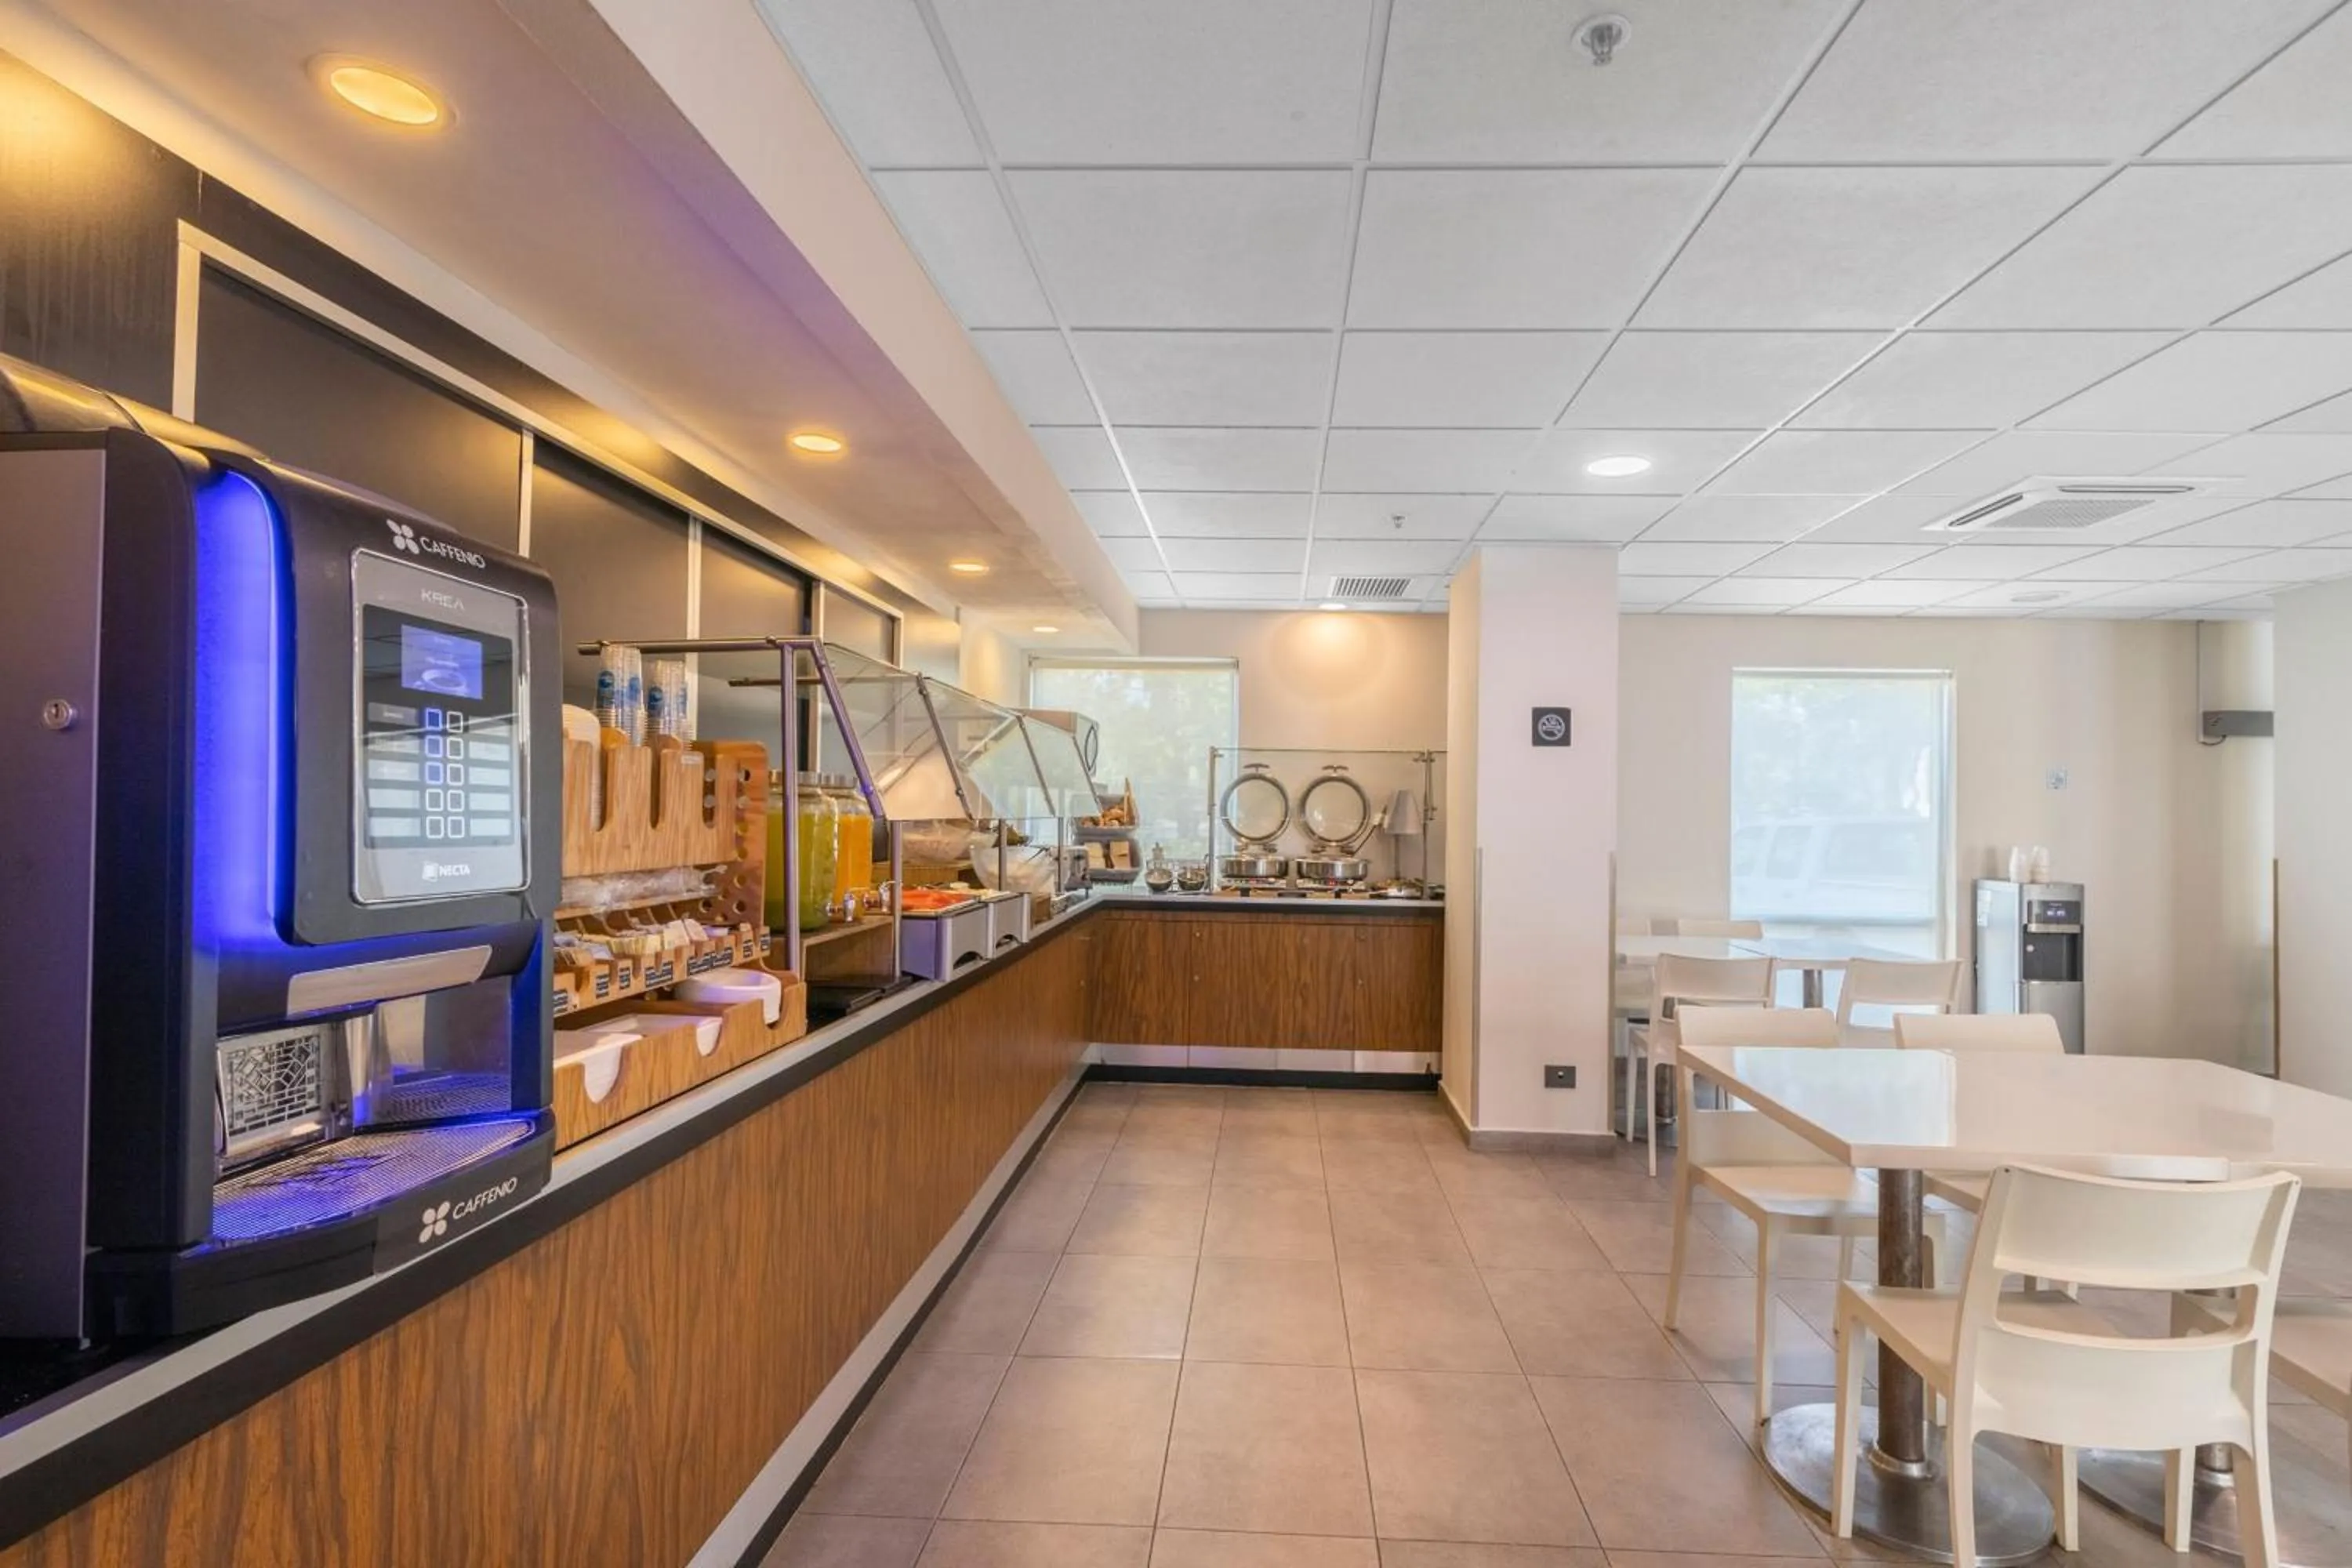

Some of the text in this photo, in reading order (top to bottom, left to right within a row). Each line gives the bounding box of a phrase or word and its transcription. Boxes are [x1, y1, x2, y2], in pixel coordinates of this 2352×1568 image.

[419, 536, 486, 569] CAFFENIO
[439, 863, 471, 877] NECTA
[452, 1177, 518, 1221] CAFFENIO
